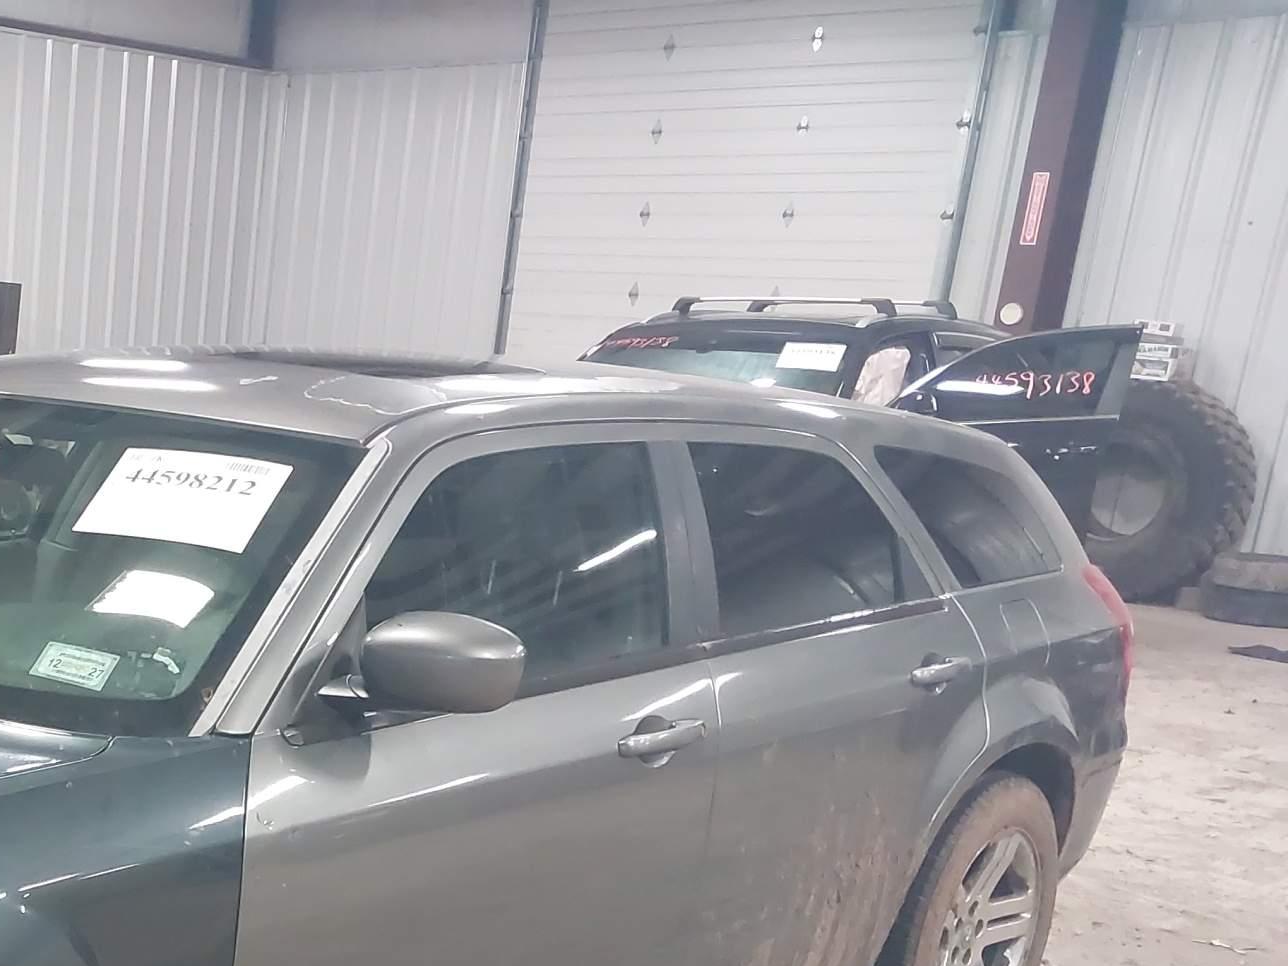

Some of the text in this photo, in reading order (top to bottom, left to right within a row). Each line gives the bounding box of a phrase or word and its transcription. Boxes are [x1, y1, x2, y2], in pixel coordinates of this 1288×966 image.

[975, 371, 1095, 400] 44593138
[125, 467, 257, 496] 44598212
[48, 658, 63, 669] 12
[88, 667, 104, 679] 27
